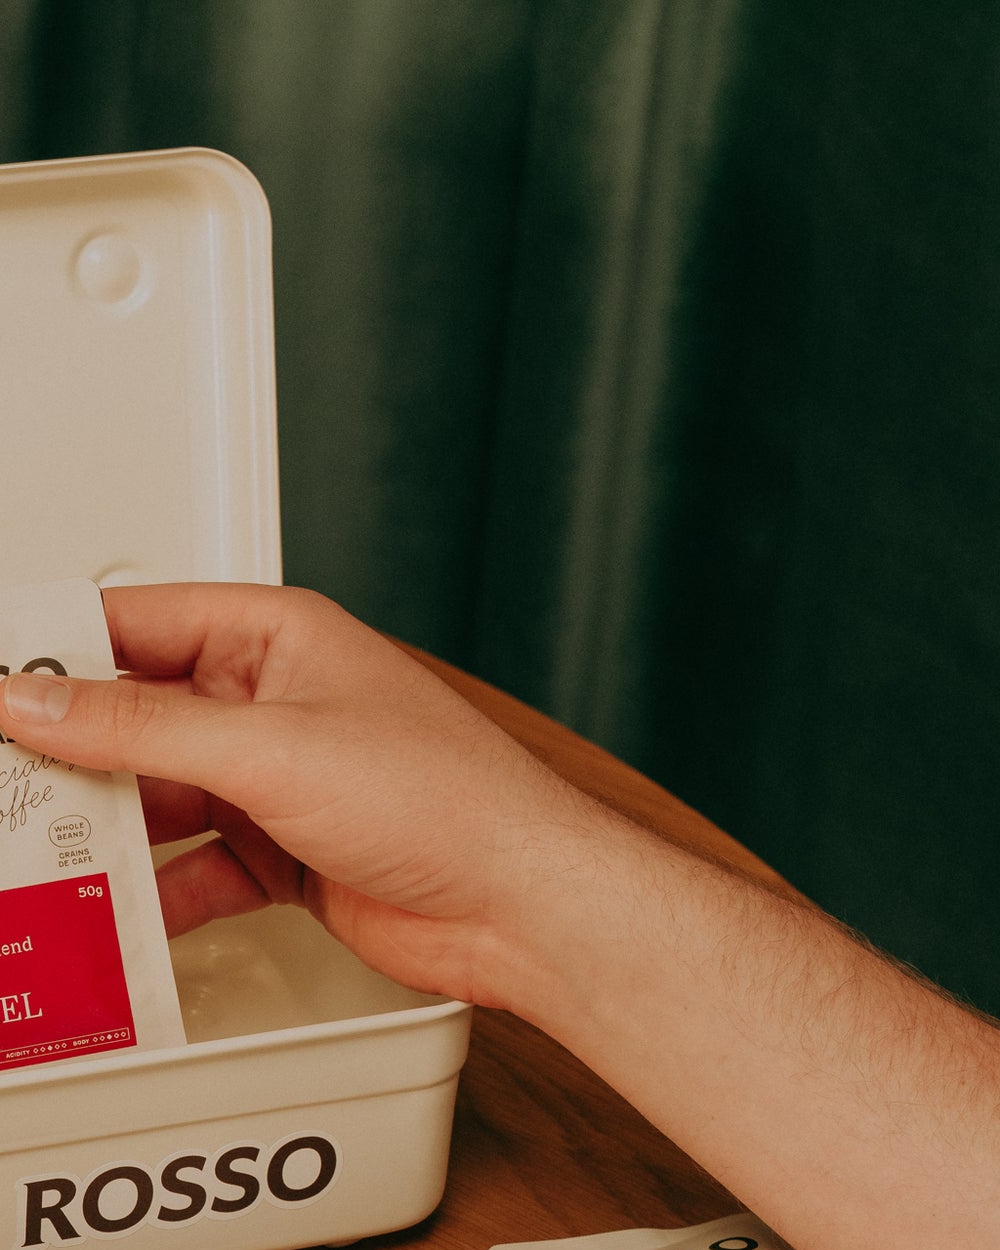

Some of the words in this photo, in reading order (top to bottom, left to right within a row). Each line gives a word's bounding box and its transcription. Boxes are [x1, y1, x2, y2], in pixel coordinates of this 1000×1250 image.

[54, 822, 84, 833] WHOLE
[57, 831, 84, 841] BEANS
[59, 848, 90, 859] GRAINS
[58, 859, 69, 868] DE
[78, 885, 103, 898] 50g
[6, 1049, 30, 1059] ACIDITY
[73, 1038, 90, 1047] BODY
[21, 1136, 337, 1247] ROSSO
